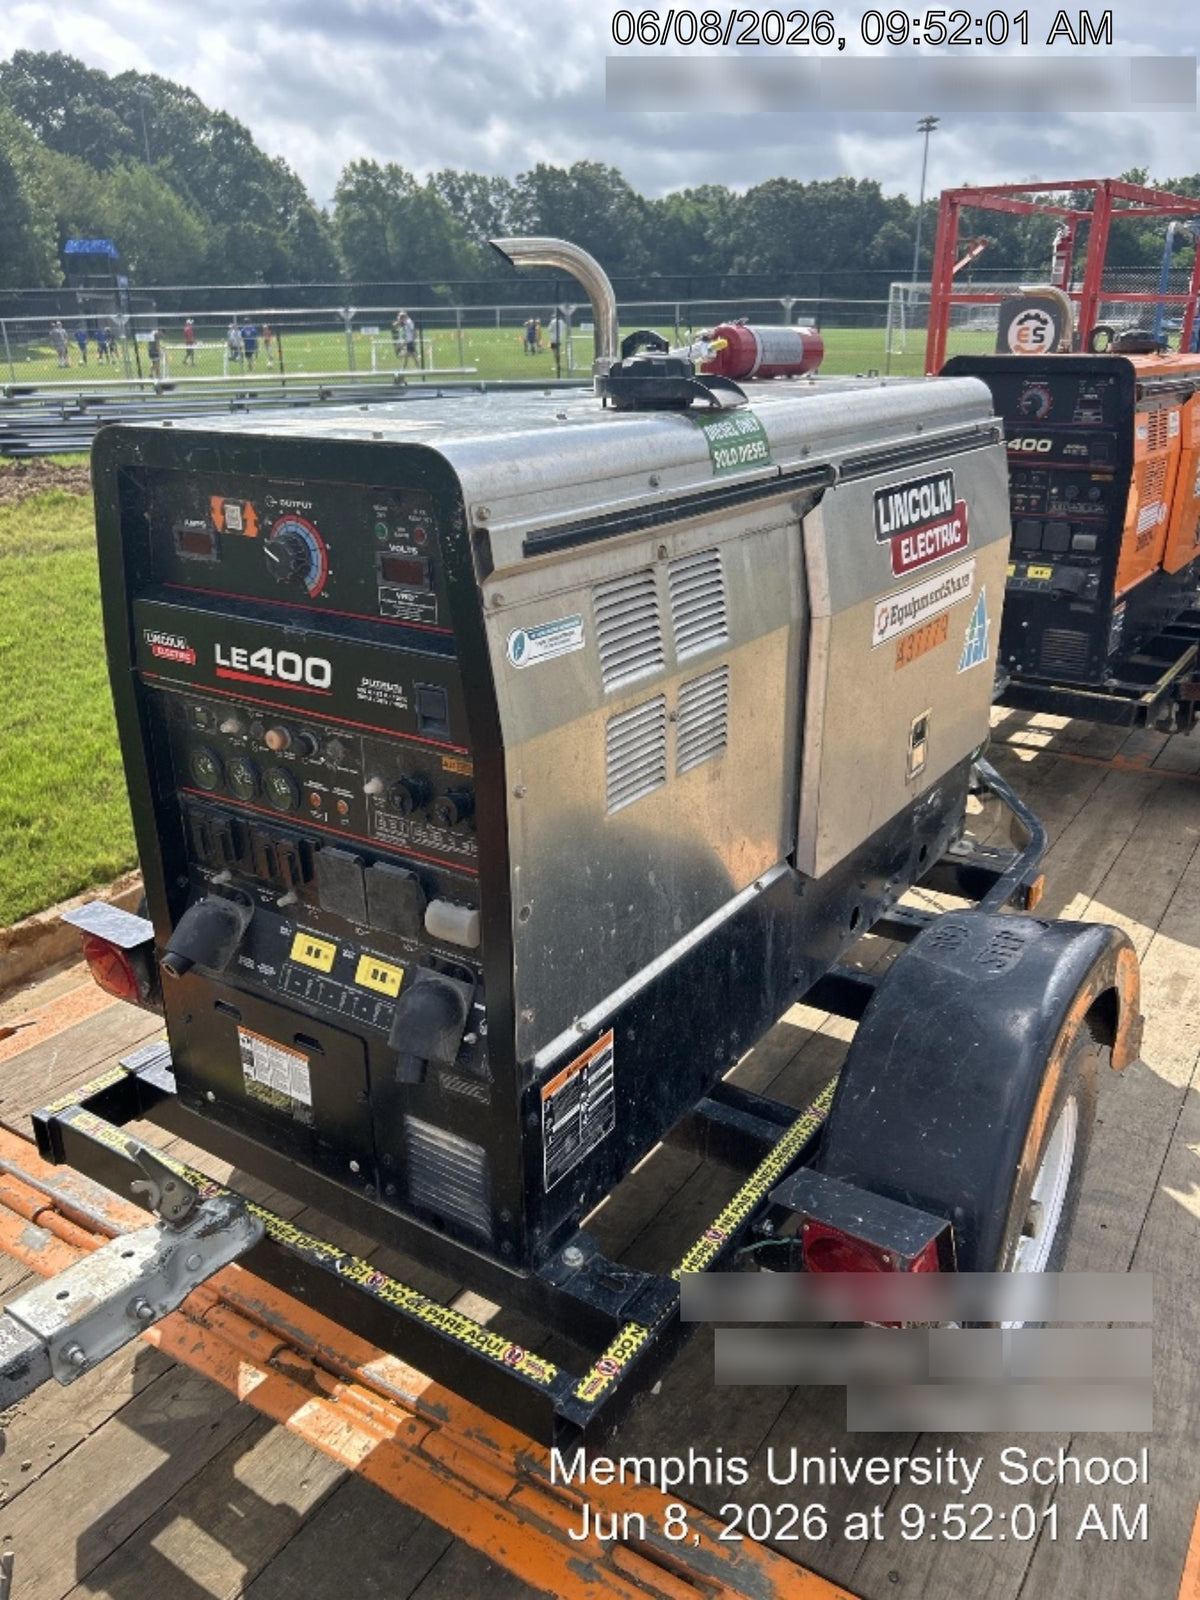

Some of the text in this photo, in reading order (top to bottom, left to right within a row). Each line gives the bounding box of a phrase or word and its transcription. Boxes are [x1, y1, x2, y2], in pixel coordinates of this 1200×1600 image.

[1017, 326, 1046, 343] ES
[714, 441, 768, 468] SOLO DIESEL
[279, 499, 312, 509] OUTPUT
[878, 478, 953, 533] LINCOLN
[901, 519, 961, 565] ELECTRIC
[889, 573, 971, 626] EquipmentShare
[214, 643, 332, 689] LE400
[382, 1283, 406, 1300] NO
[425, 1306, 466, 1333] PARE
[612, 1337, 633, 1360] DO
